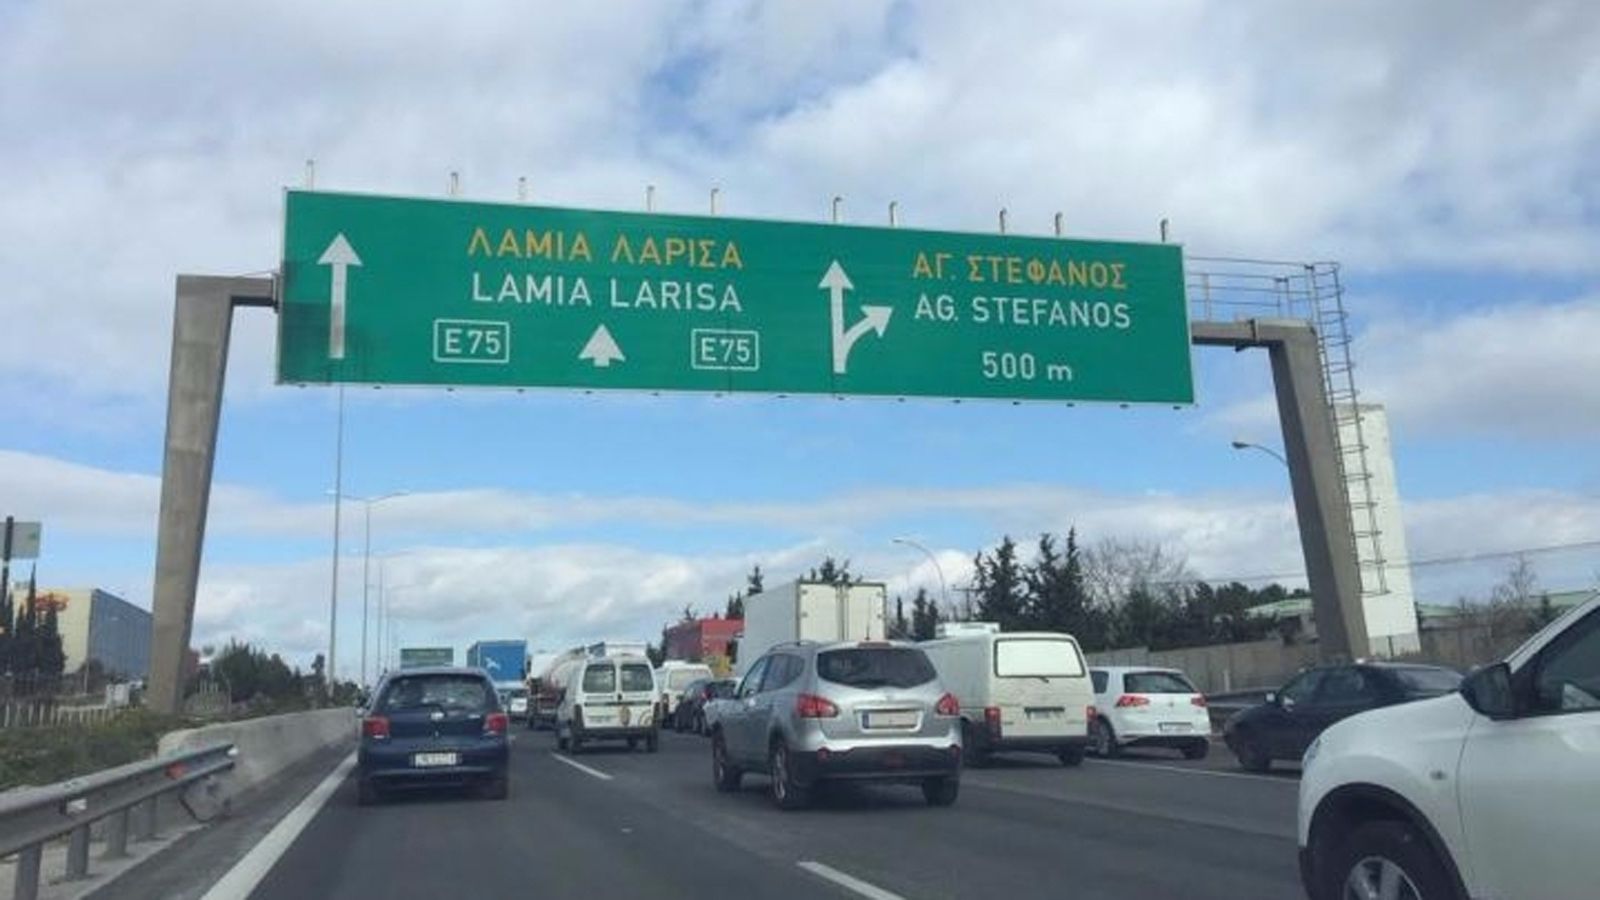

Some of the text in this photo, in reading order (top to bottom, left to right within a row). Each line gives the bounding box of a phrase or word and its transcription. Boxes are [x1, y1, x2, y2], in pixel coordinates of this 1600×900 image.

[468, 228, 743, 270] ΛΑΜΙΑ ΛΑΡΙΣΑ
[912, 253, 1126, 288] ΑΓ. ΣΤΕΦΑΝΟΣ
[472, 272, 743, 312] LAMIA LARISA
[914, 295, 1131, 329] AG. STEFANOS
[982, 351, 1073, 381] 500 m
